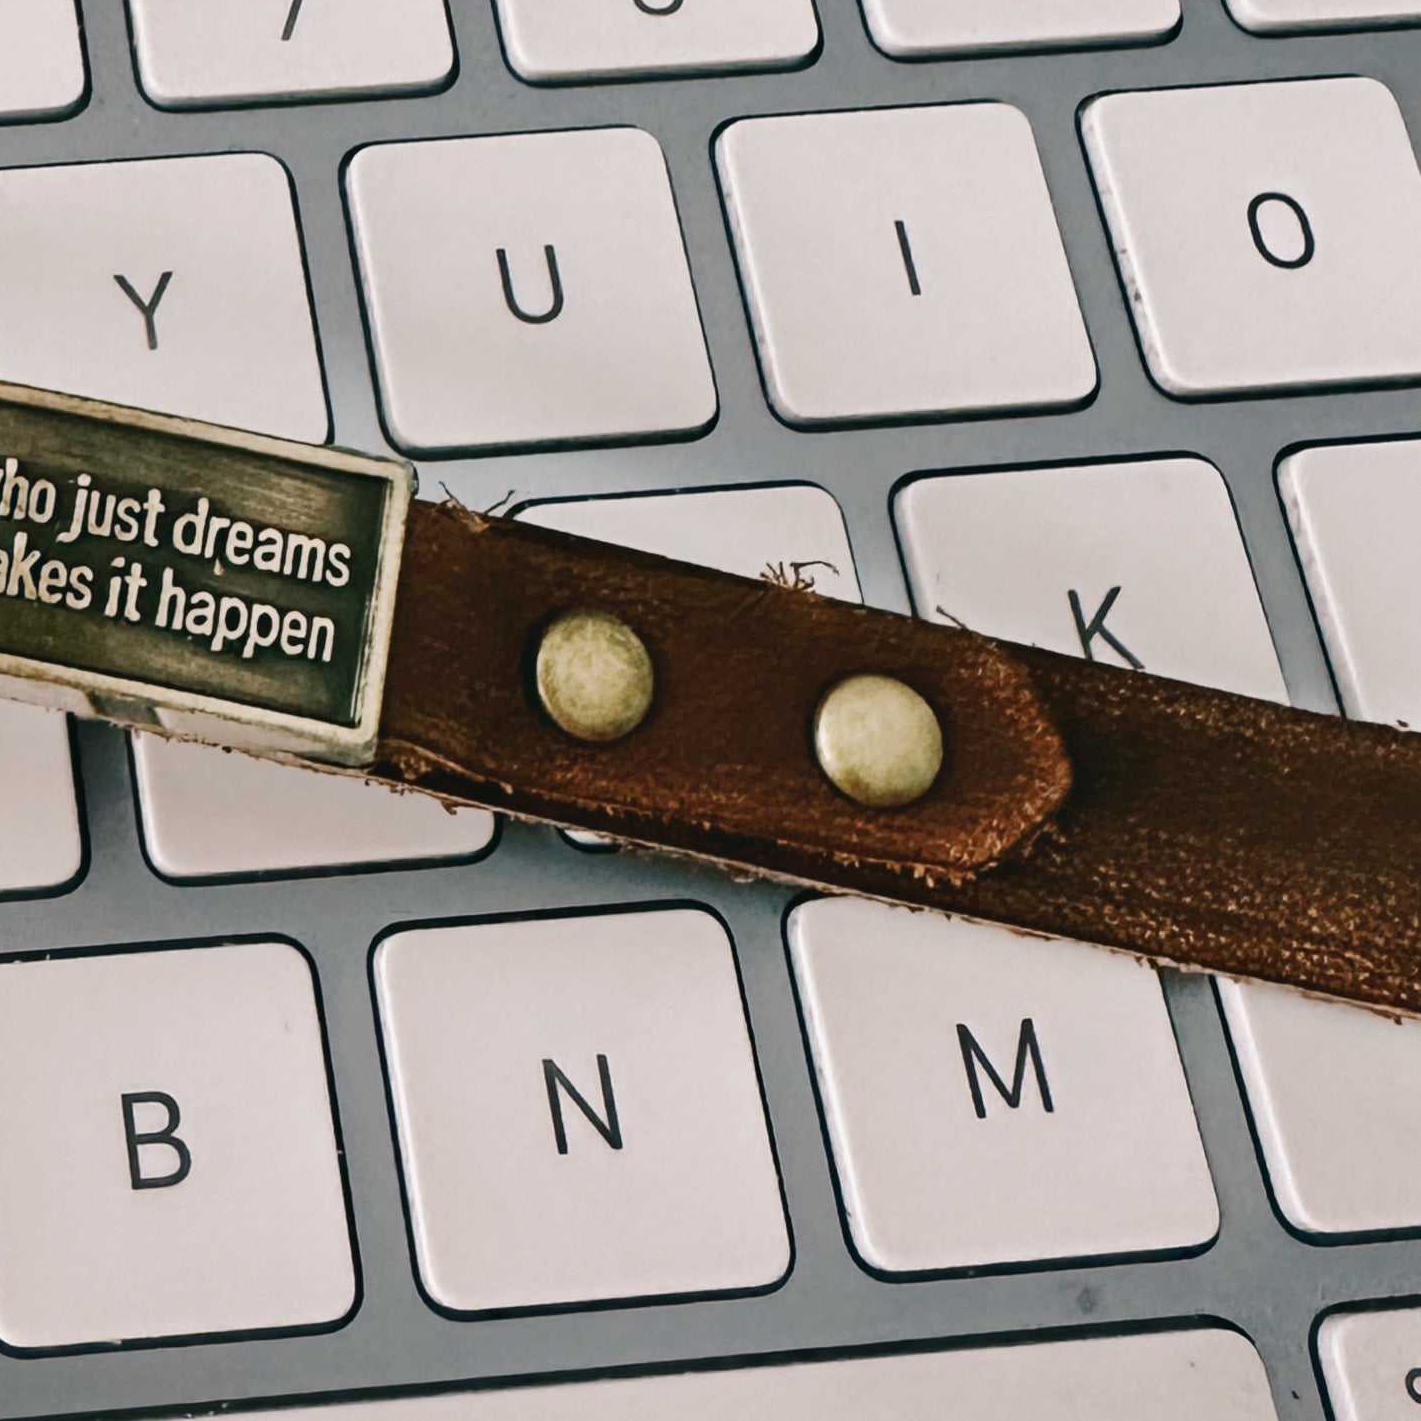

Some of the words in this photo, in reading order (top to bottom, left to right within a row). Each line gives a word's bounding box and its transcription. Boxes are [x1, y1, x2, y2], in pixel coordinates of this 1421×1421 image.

[893, 219, 922, 297] I
[1246, 191, 1316, 271] O
[112, 270, 174, 351] Y
[495, 244, 565, 326] U
[55, 472, 166, 548] just
[172, 496, 352, 588] dreams
[104, 556, 148, 622] it
[155, 566, 335, 663] happen
[1068, 585, 1146, 669] K
[541, 1053, 624, 1156] N
[955, 1017, 1055, 1120] M
[120, 1090, 193, 1191] B
